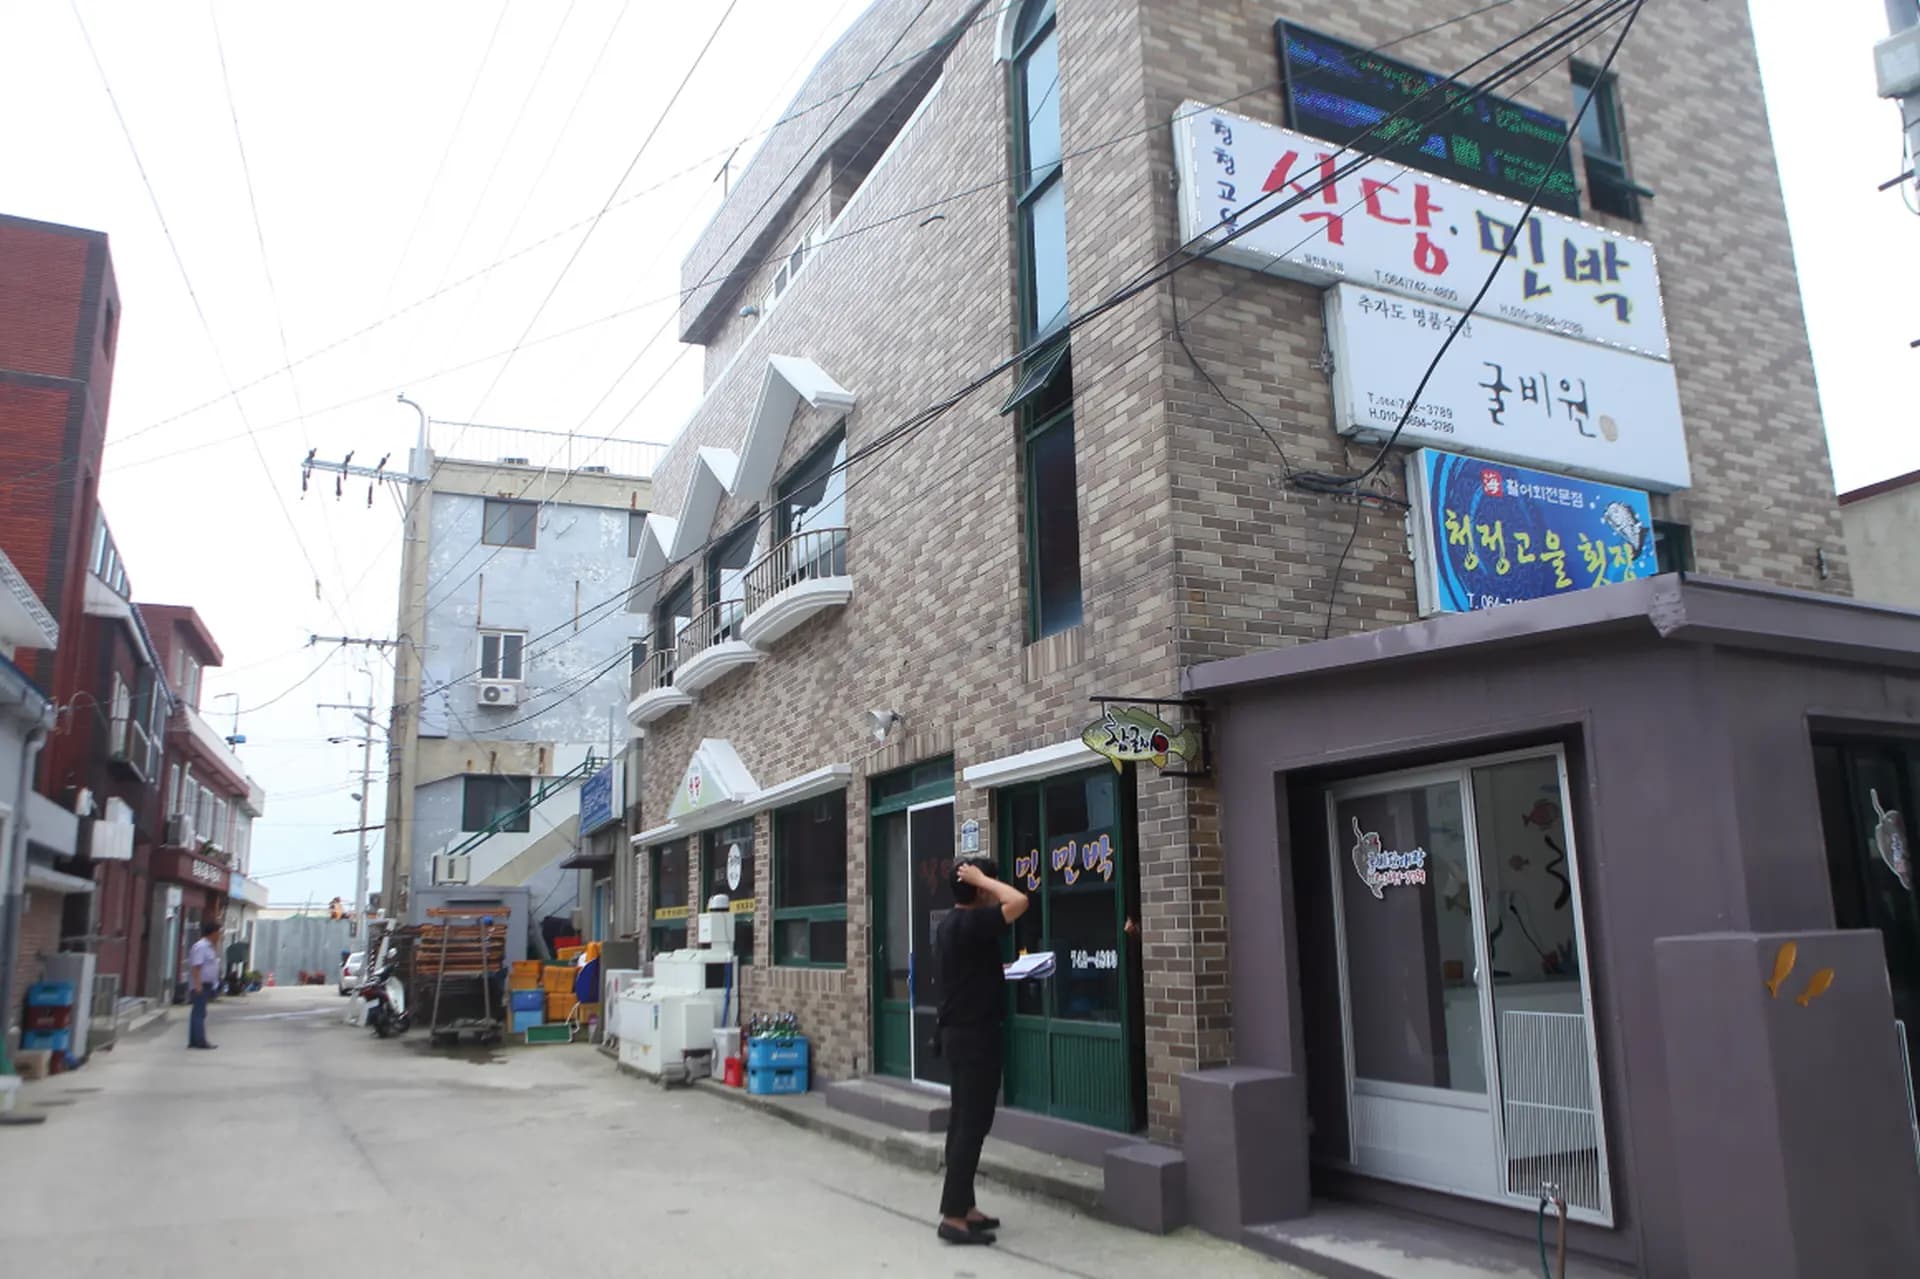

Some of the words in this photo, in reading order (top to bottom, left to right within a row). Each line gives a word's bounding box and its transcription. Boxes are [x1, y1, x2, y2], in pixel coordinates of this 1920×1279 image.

[1358, 294, 1407, 320] 추자도
[1478, 361, 1597, 438] 굴비원
[1506, 478, 1585, 508] 활어회전문점
[1445, 508, 1573, 589] 청정고을
